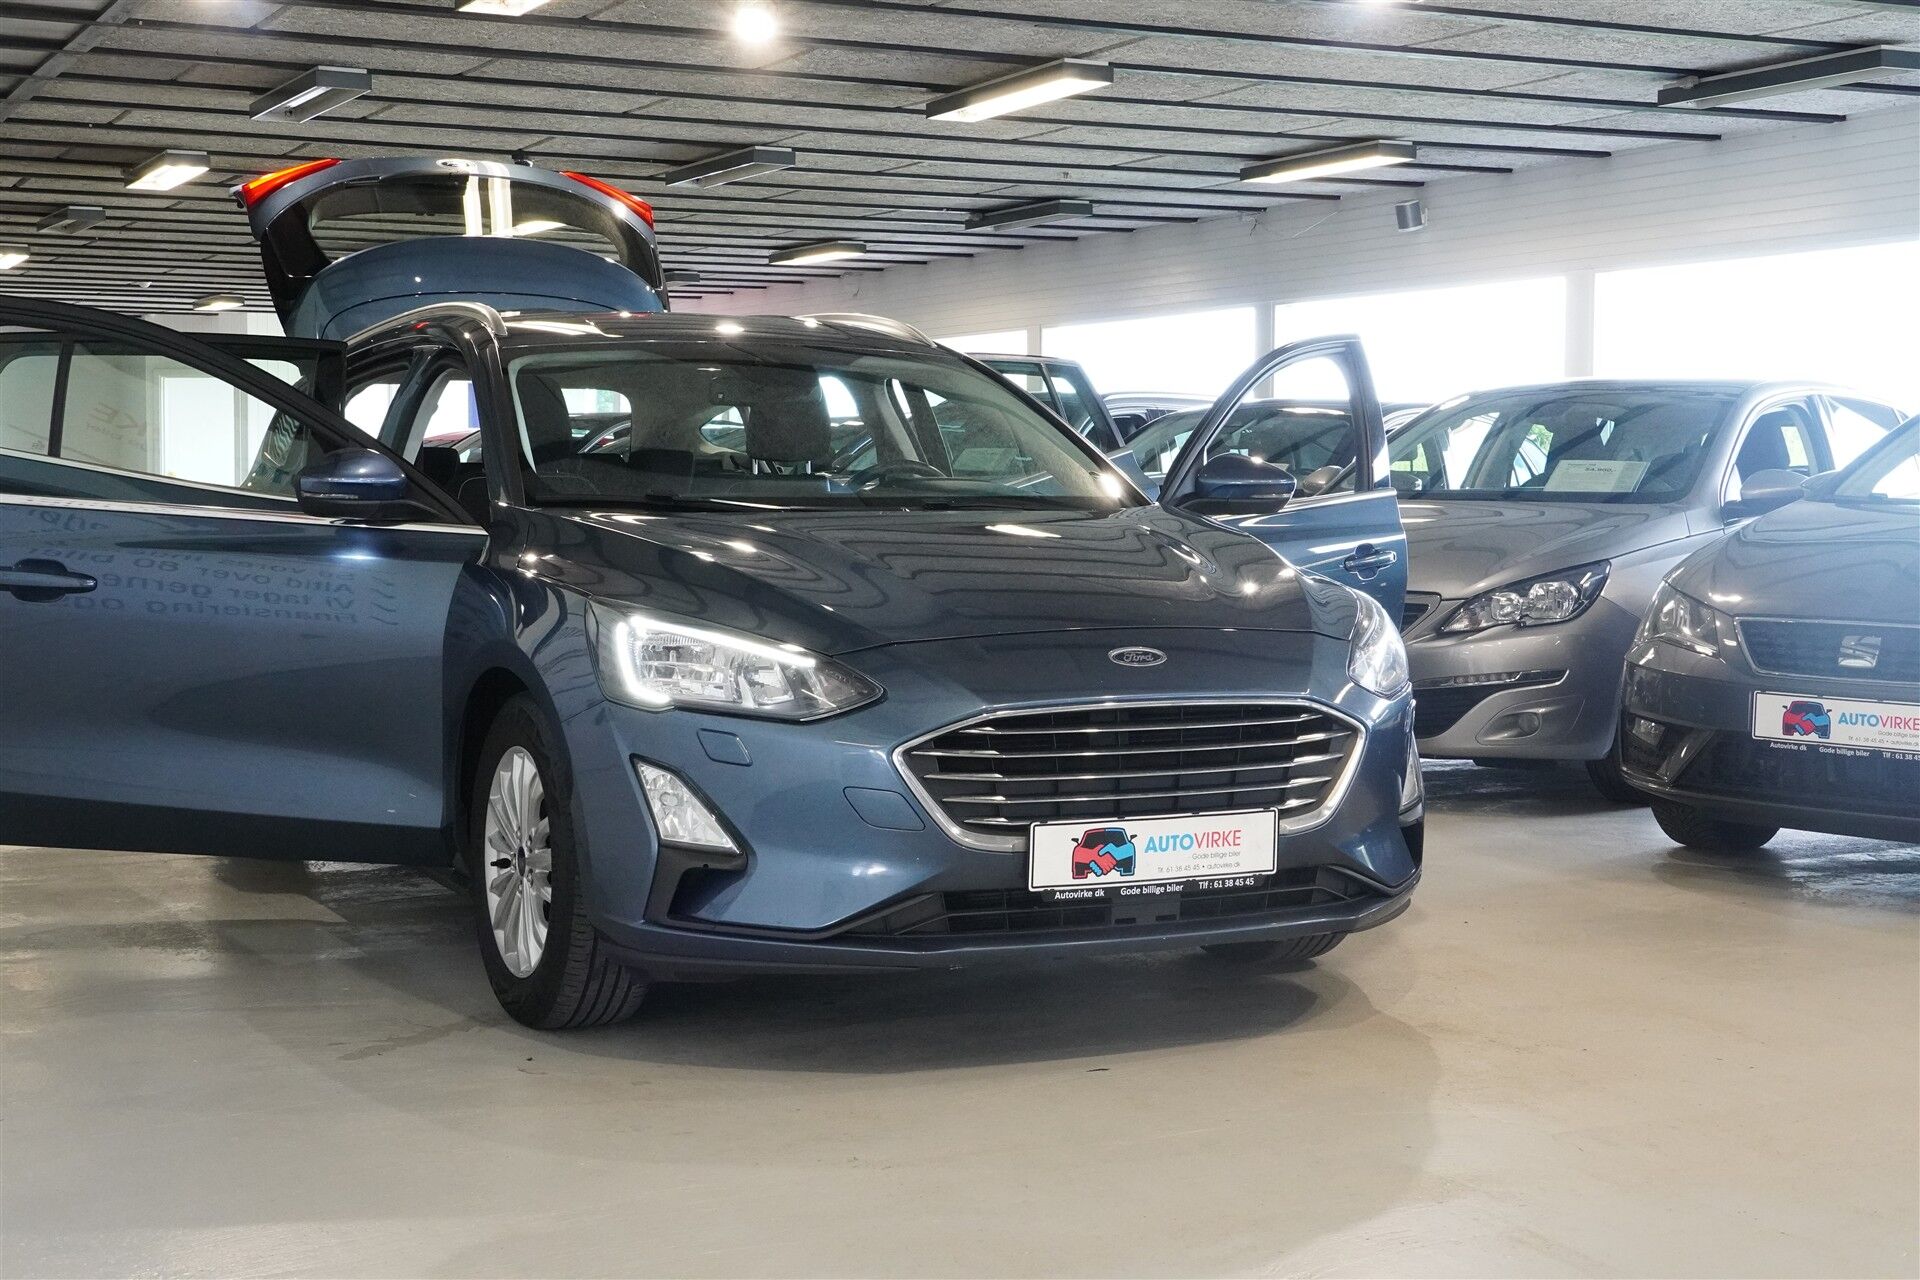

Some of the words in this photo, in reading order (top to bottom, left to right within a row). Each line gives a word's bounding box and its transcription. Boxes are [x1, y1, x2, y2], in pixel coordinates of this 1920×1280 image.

[1123, 651, 1154, 662] Ford
[1838, 712, 1920, 731] AUTOVIRKE
[1770, 742, 1797, 750] Autovirke
[1819, 746, 1836, 754] Gode
[1836, 748, 1855, 757] billige
[1144, 830, 1242, 854] AUTOVIRKE
[1192, 852, 1210, 860] Gode
[1183, 864, 1192, 872] 45
[1213, 880, 1223, 889] 61
[1224, 879, 1234, 888] 38
[1234, 878, 1244, 887] 45
[1245, 877, 1255, 886] 45
[1054, 890, 1093, 899] Autovirke
[1094, 889, 1105, 897] dk
[1120, 886, 1143, 896] Gode
[1142, 885, 1166, 895] billige
[1166, 884, 1184, 893] biler
